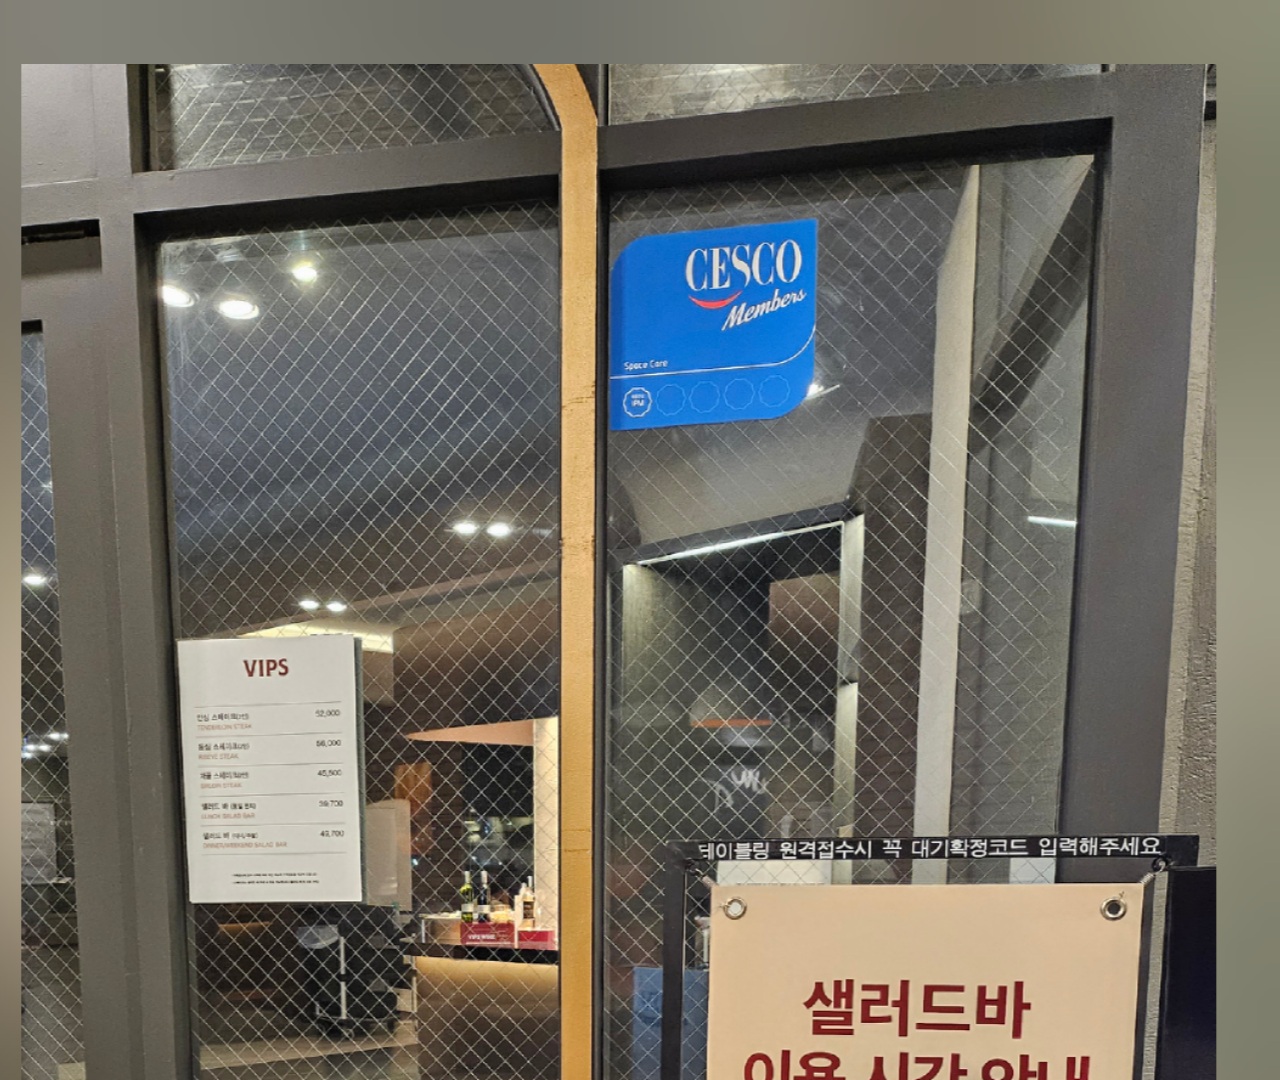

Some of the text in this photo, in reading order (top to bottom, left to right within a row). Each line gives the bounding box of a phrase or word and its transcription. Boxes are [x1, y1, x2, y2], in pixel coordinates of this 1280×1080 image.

[685, 239, 803, 291] CESCO
[721, 288, 808, 332] Members
[243, 658, 289, 677] VIPS
[779, 840, 873, 860] 원격접수시
[882, 839, 903, 859] 꼭
[910, 837, 1030, 857] 대기확정코드
[1038, 836, 1162, 857] 입력해주세요
[803, 978, 1032, 1039] 샐러드바
